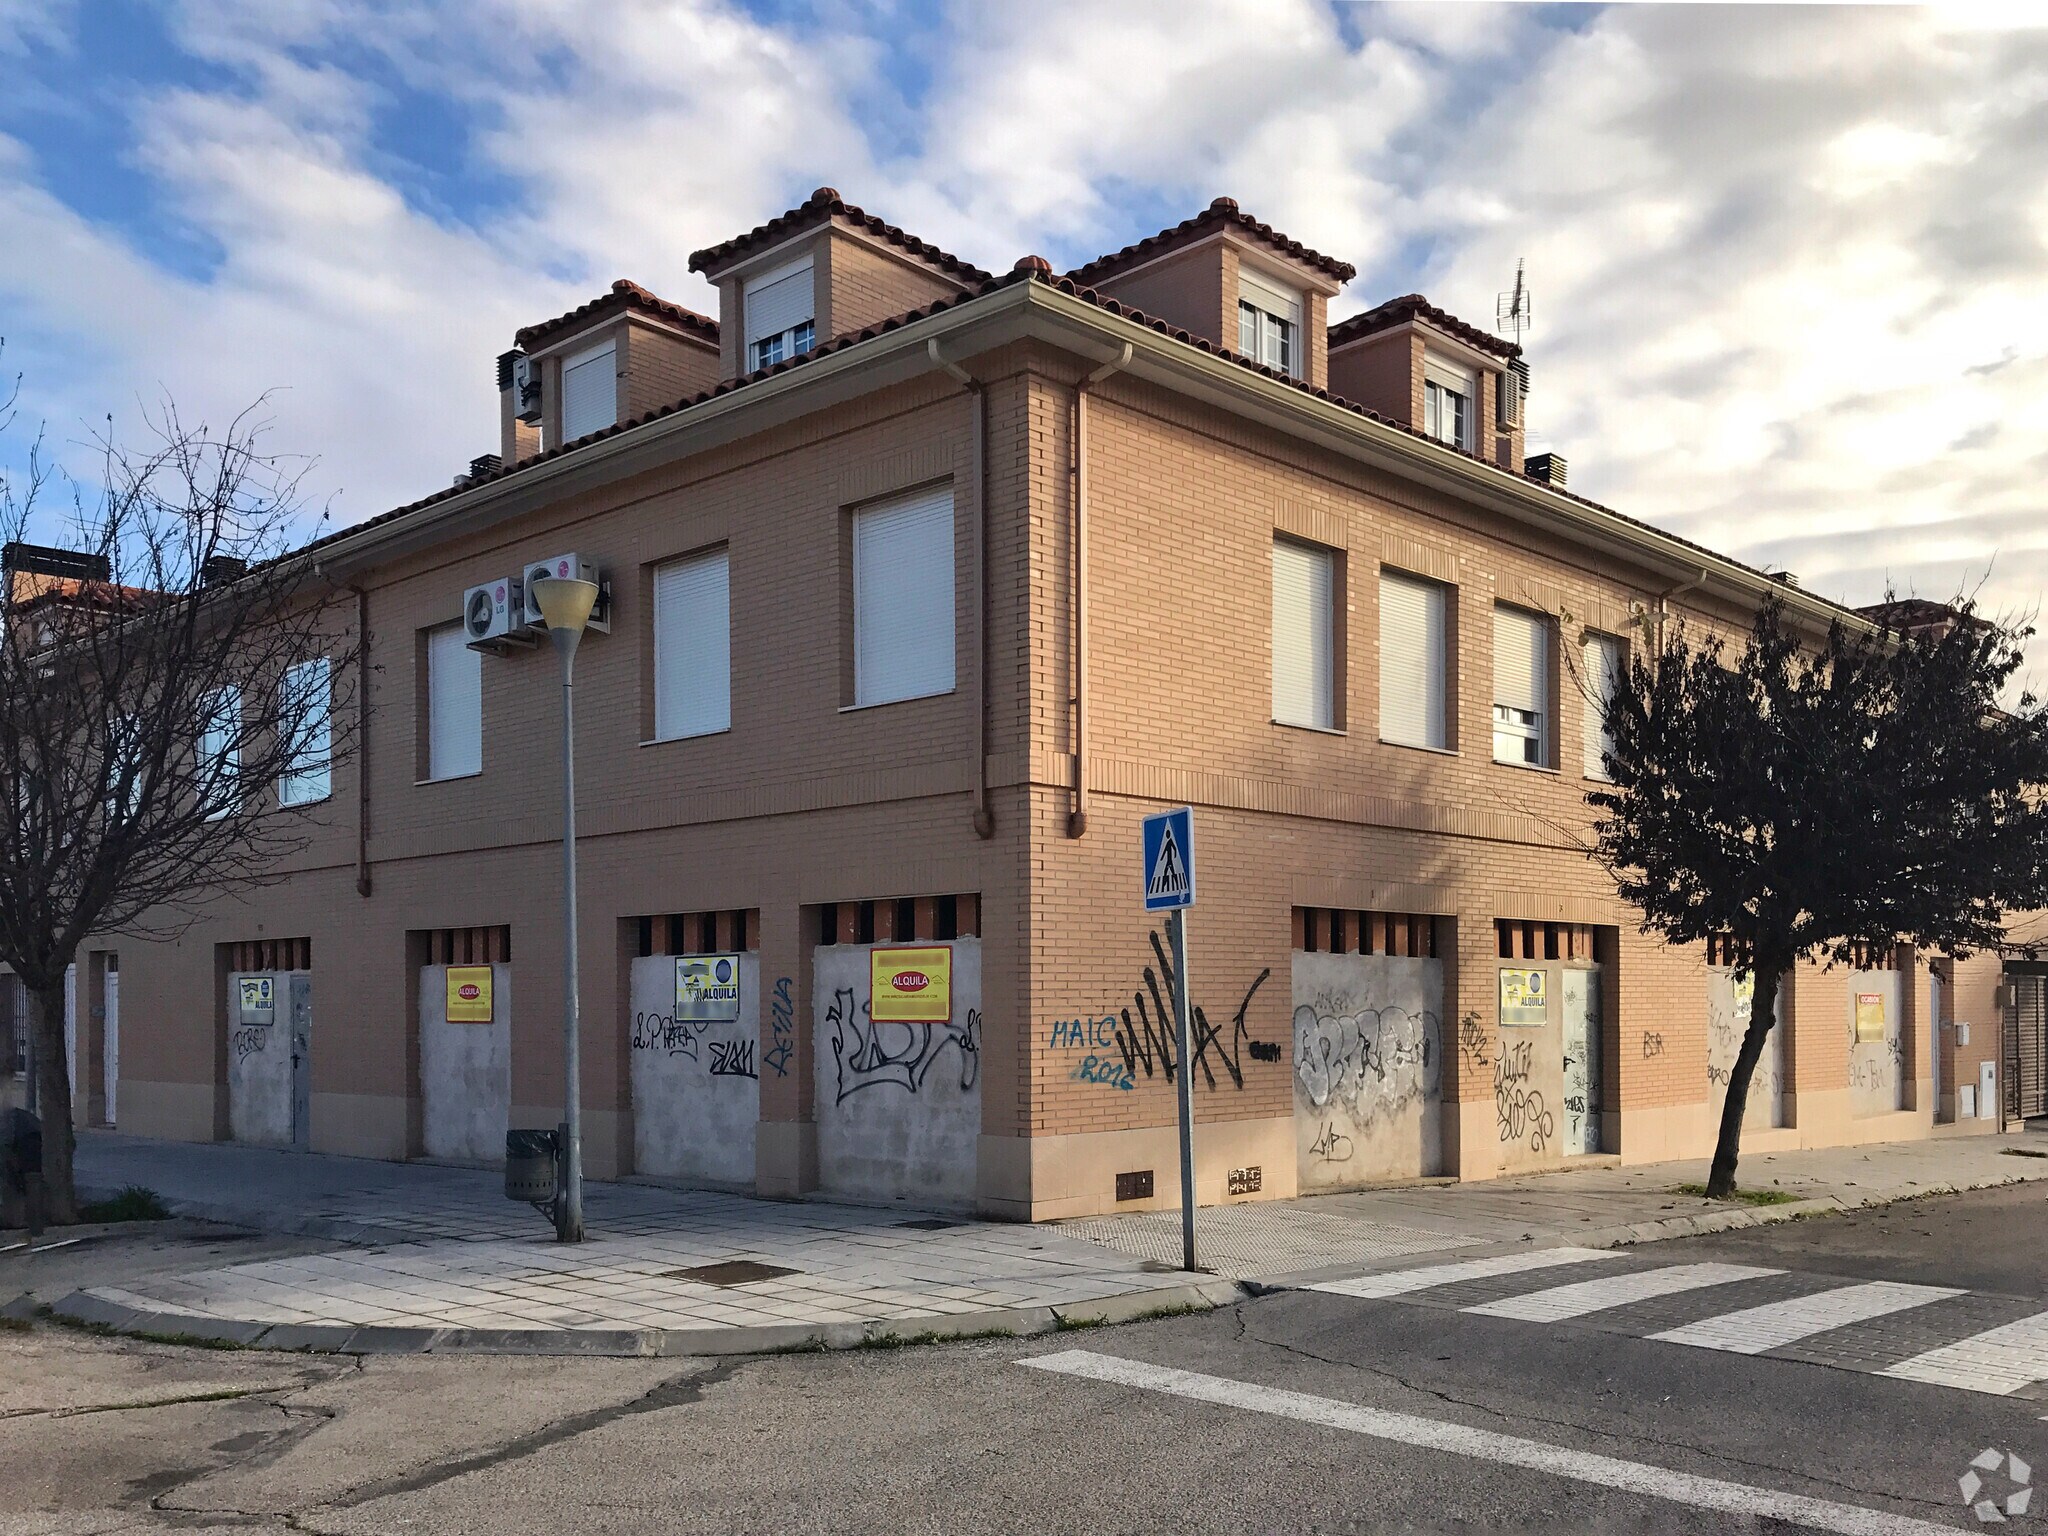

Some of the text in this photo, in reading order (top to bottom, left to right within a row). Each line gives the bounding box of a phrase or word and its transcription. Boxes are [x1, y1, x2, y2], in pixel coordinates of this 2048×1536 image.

[496, 605, 504, 614] LG
[893, 976, 928, 985] ALQUILA
[703, 988, 736, 1000] ALQUILA
[1521, 997, 1544, 1006] ALQUILA
